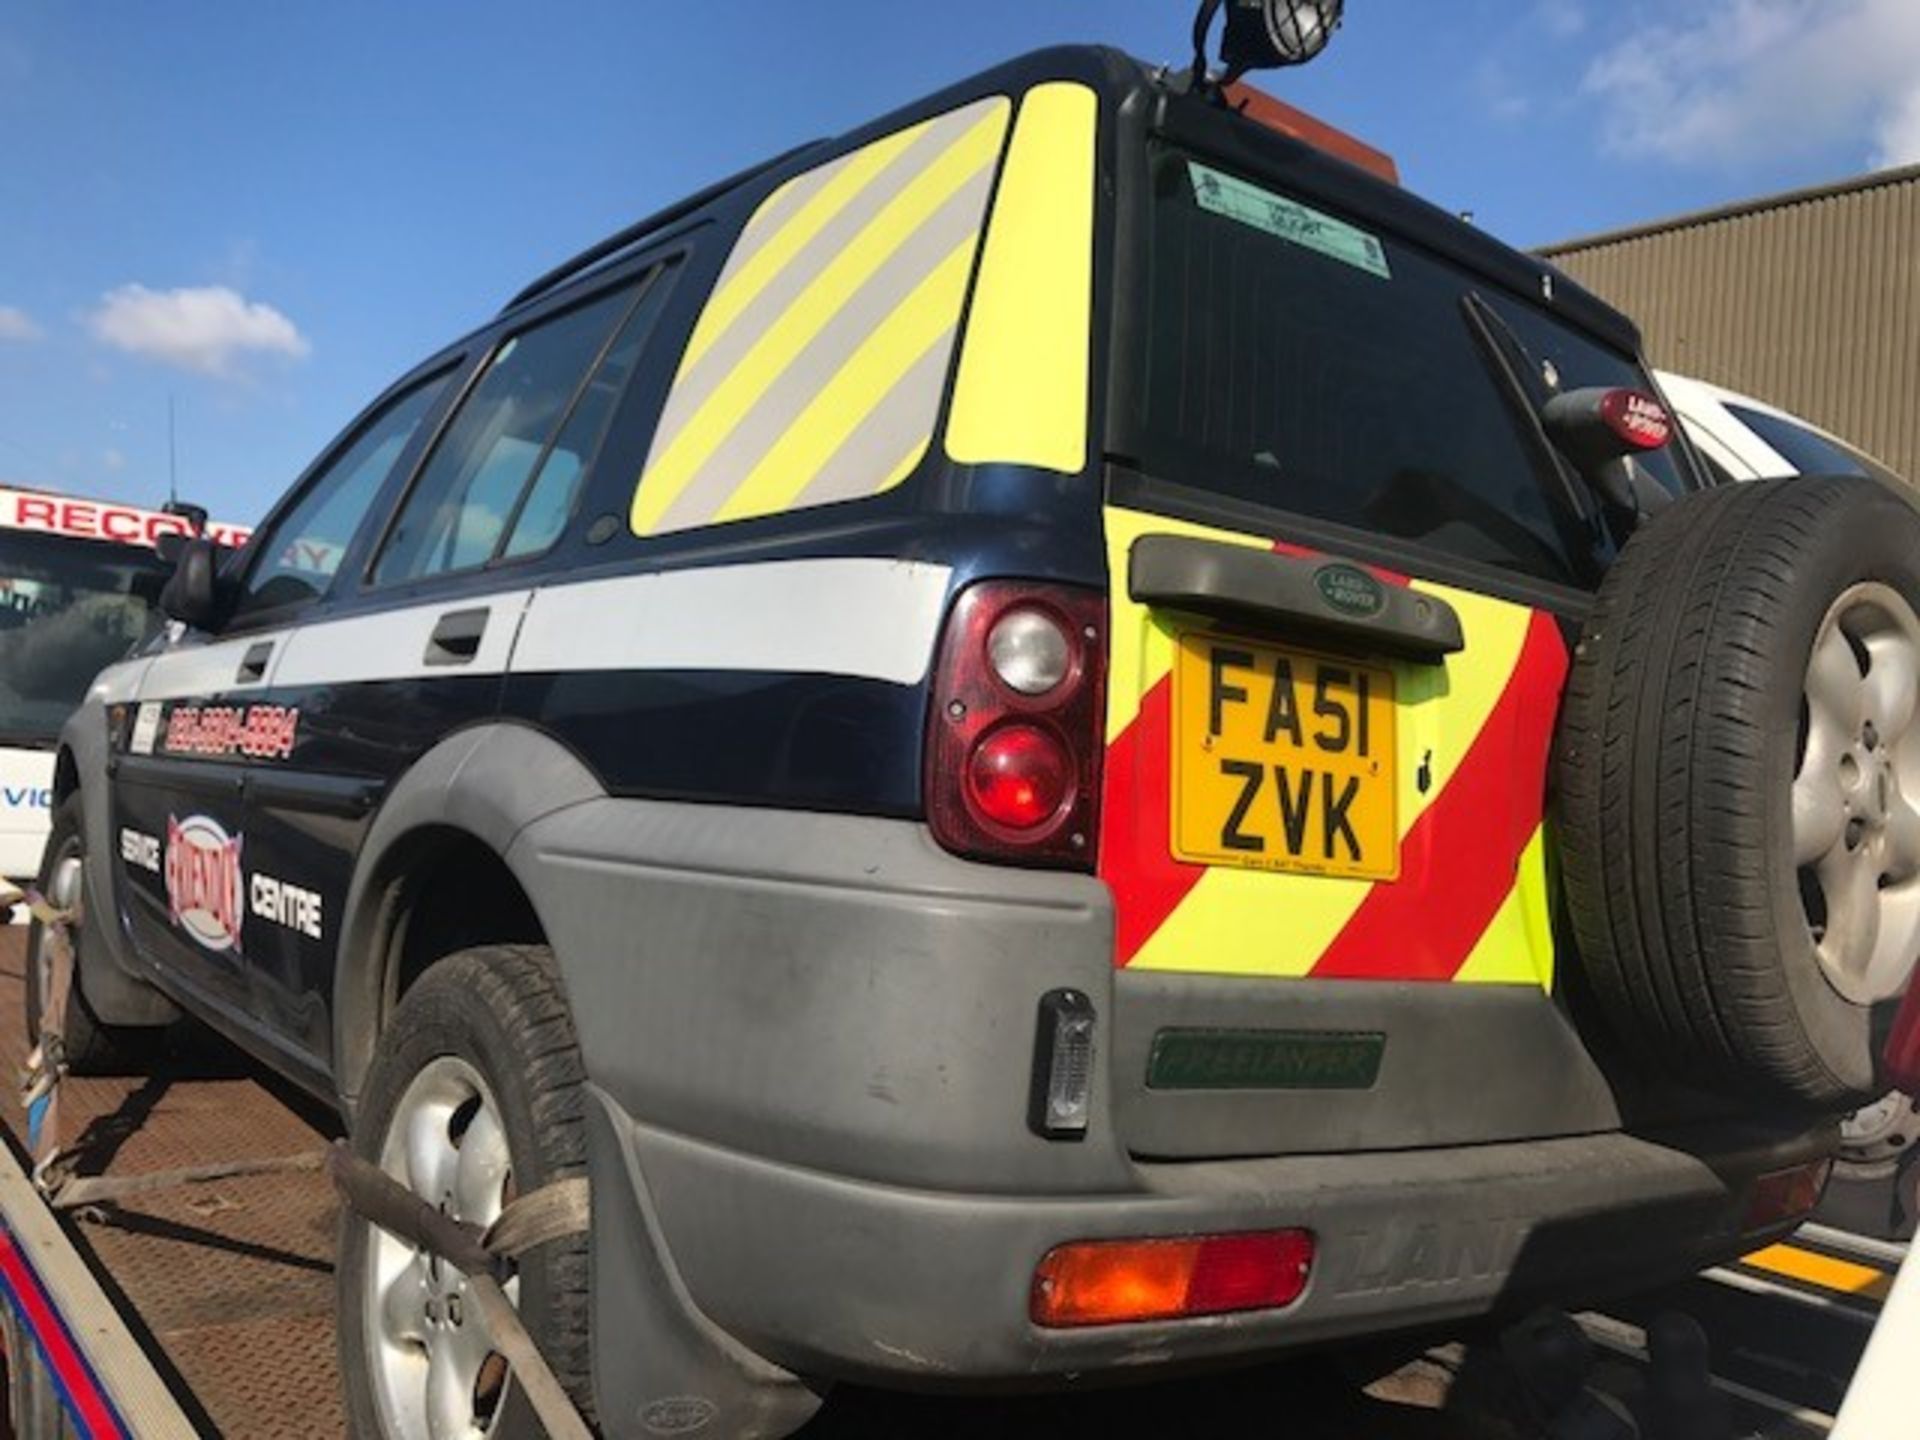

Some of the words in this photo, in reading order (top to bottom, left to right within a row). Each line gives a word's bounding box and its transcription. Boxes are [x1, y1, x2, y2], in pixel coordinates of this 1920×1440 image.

[1210, 648, 1369, 757] FA51
[1220, 758, 1362, 862] ZVK
[251, 872, 323, 940] CENTRE
